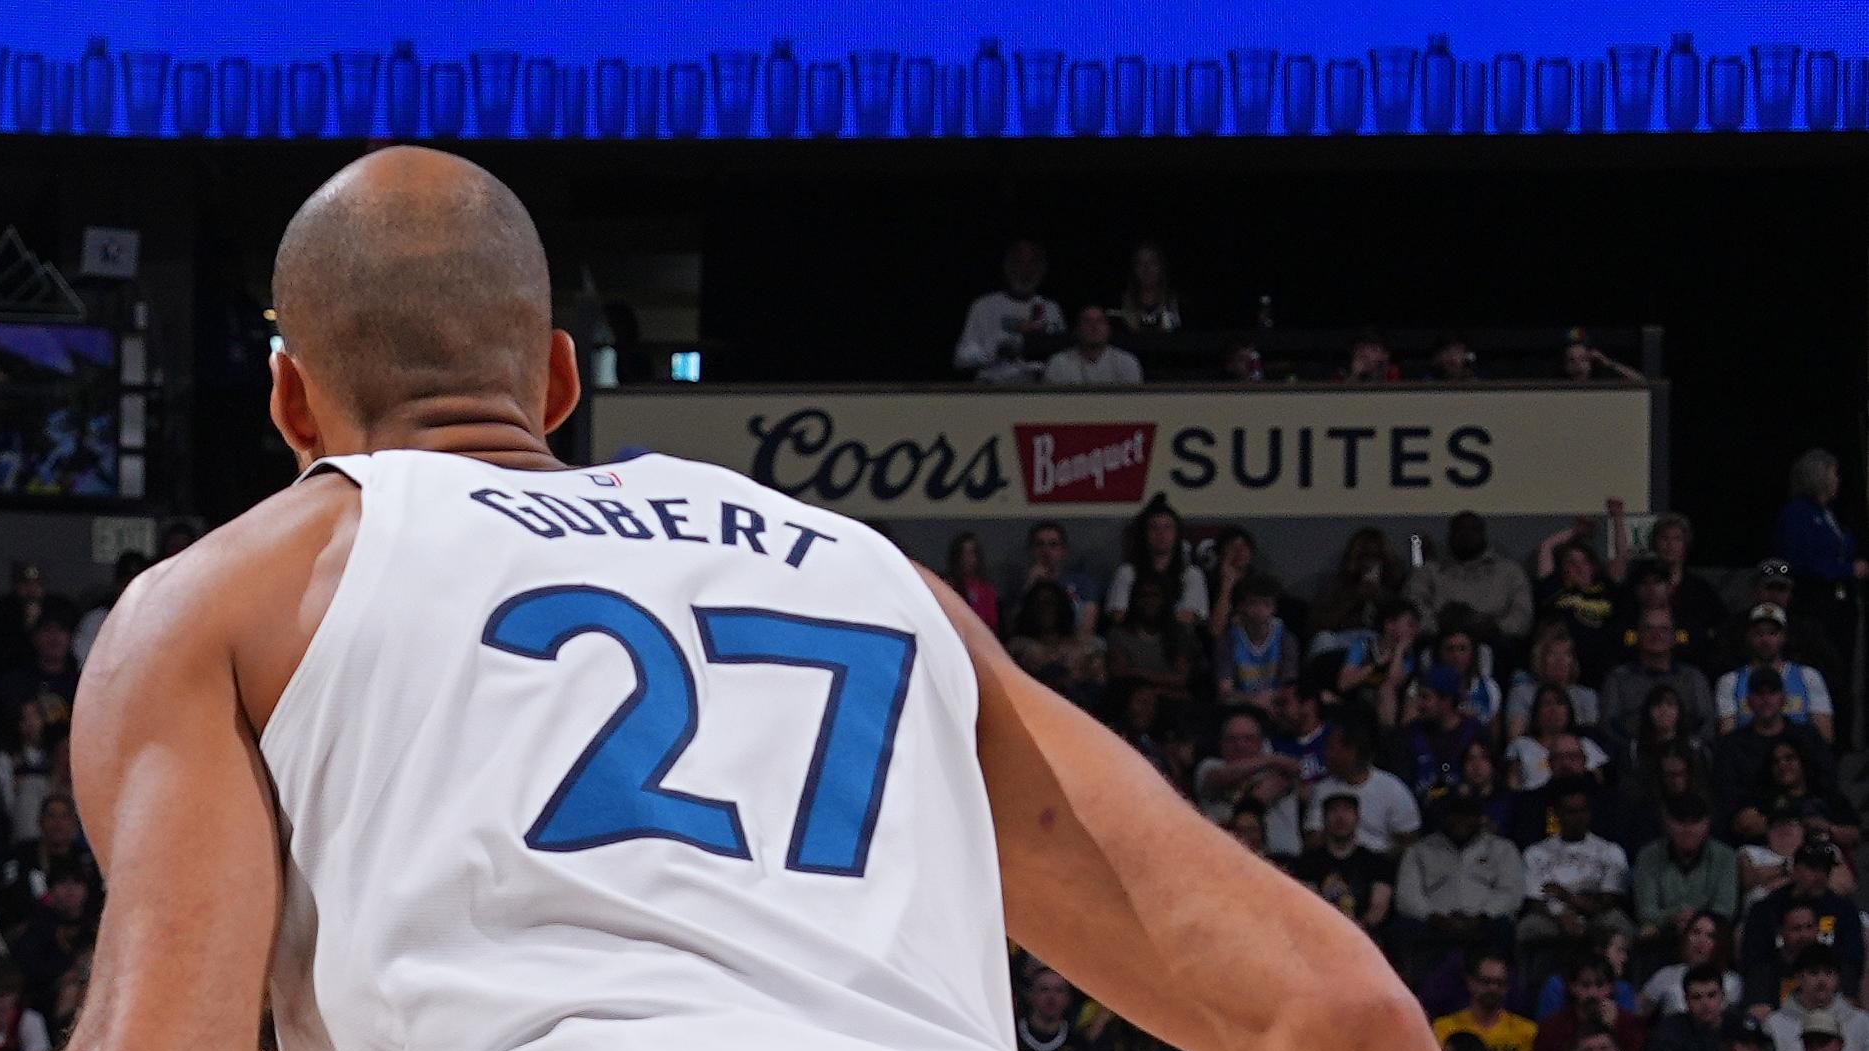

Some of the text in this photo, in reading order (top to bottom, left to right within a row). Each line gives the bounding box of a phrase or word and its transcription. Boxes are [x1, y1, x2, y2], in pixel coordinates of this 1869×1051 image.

[747, 409, 1493, 499] Coors Banquet SUITES
[470, 488, 838, 569] GOBERT
[481, 583, 917, 878] 27
